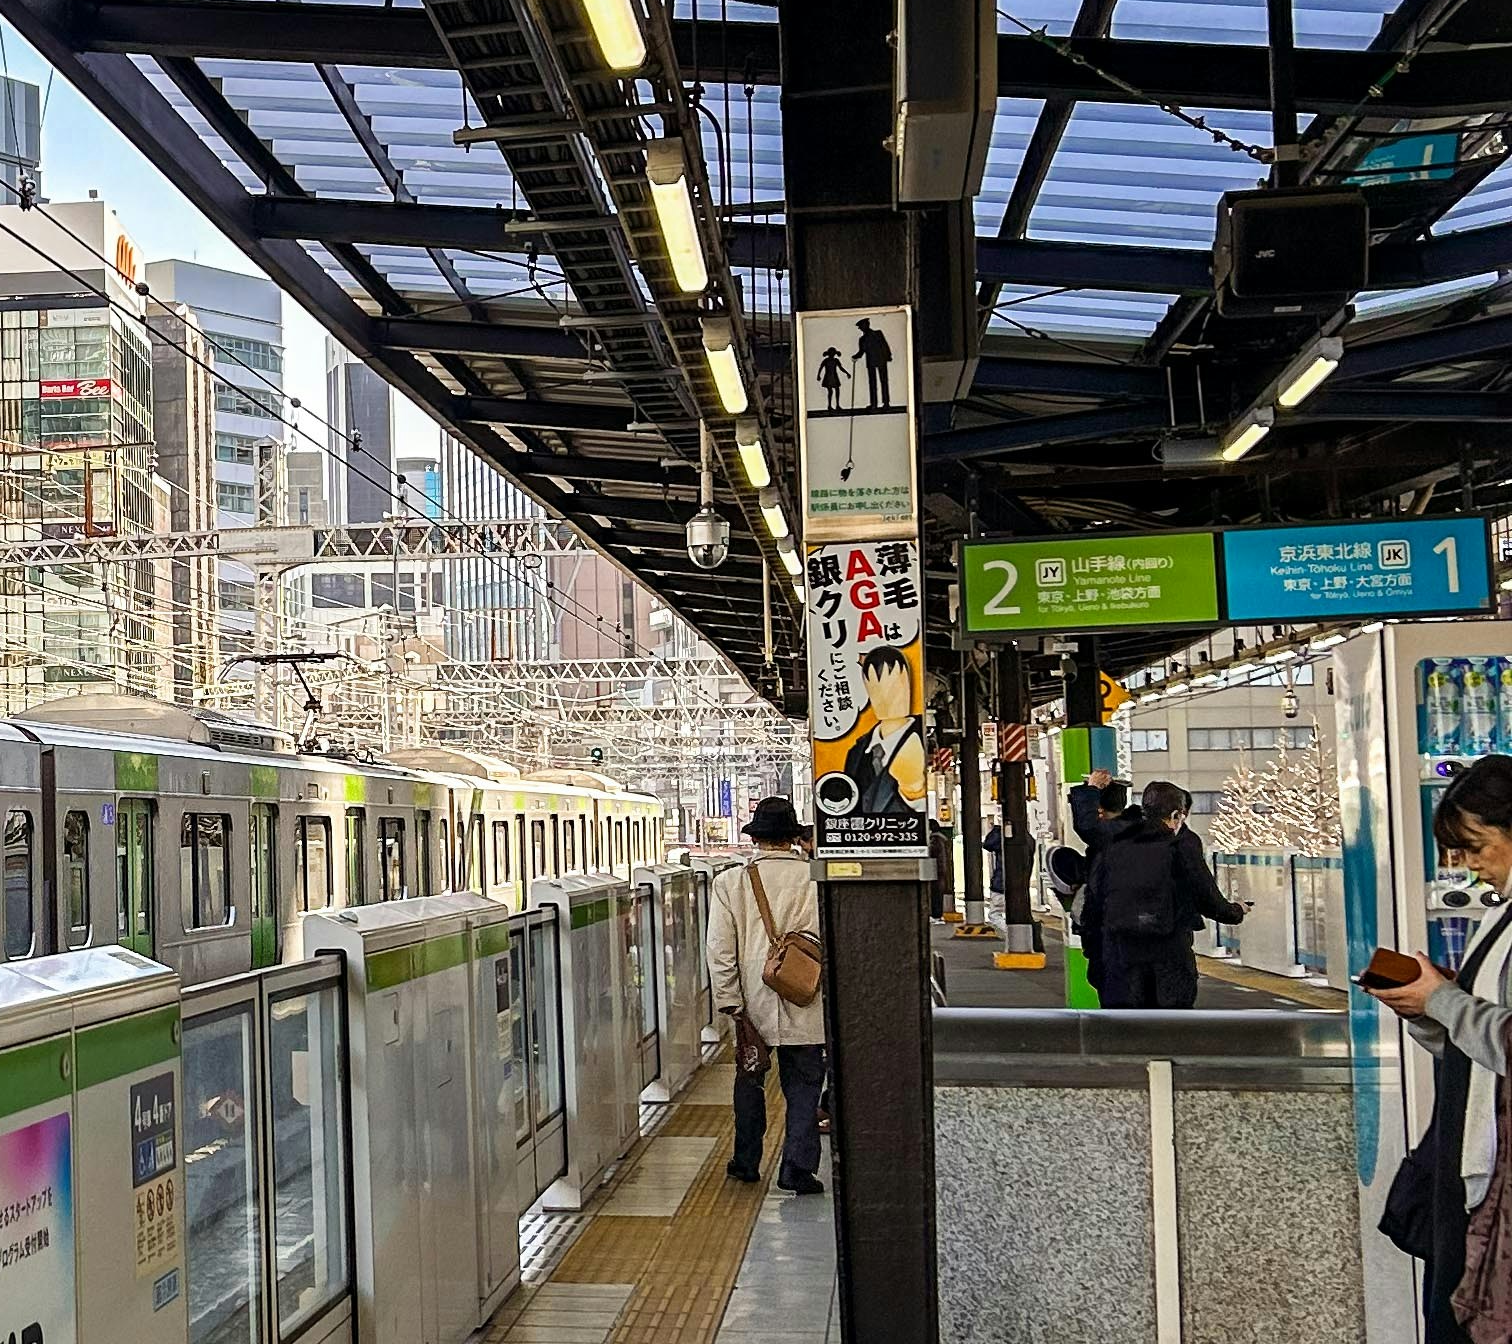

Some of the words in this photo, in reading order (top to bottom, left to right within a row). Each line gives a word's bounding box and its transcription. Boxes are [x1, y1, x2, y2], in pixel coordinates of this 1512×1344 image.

[1256, 250, 1275, 258] JVC
[77, 380, 110, 396] Bee
[1278, 542, 1372, 563] 京浜東北線
[1385, 548, 1403, 561] JK
[1350, 562, 1373, 573] Line
[1433, 536, 1459, 593] 1
[875, 542, 919, 610] 薄毛
[1042, 566, 1060, 579] JY
[1073, 575, 1126, 586] Yamanote
[1129, 573, 1152, 584] Line
[983, 560, 1021, 616] 2
[1352, 590, 1376, 598] Ueno
[845, 549, 884, 643] AGA
[1078, 602, 1100, 612] Ueno
[1110, 601, 1150, 610] Ikebukuro
[844, 832, 919, 842] 0120-972-335
